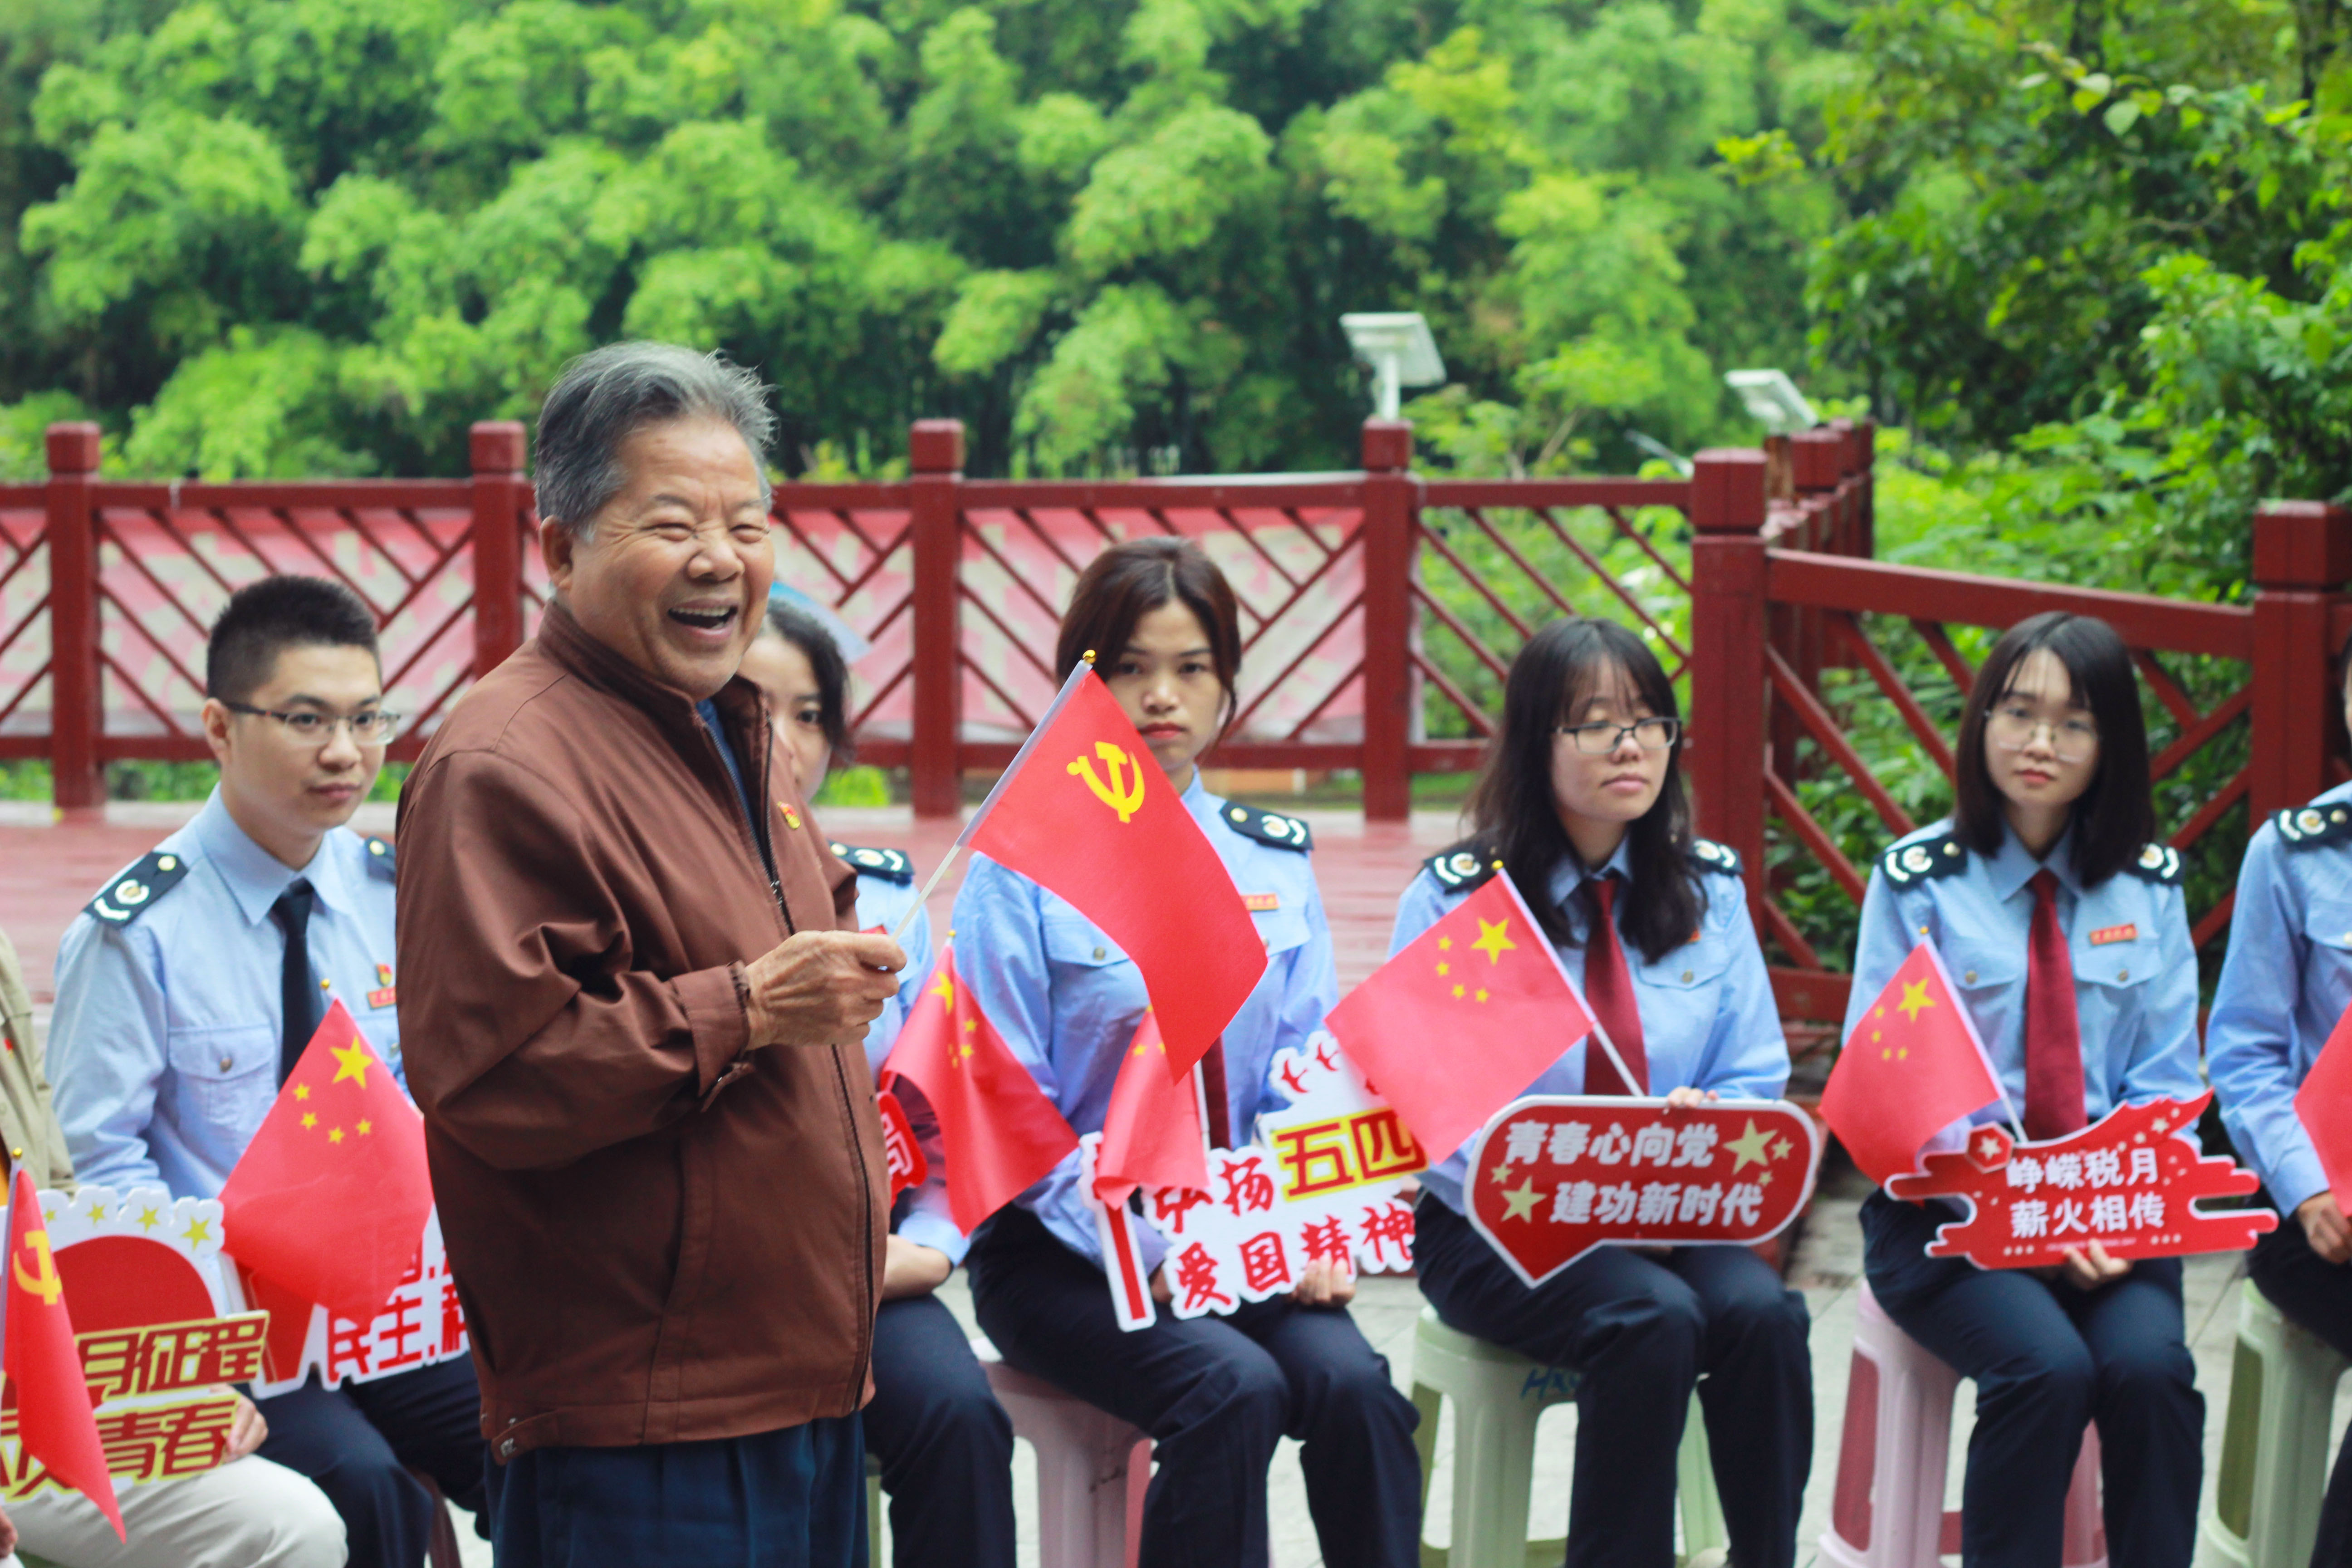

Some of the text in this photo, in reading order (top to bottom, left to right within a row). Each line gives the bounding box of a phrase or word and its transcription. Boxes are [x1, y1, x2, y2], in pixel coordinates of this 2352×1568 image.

[1504, 1119, 1719, 1168] 青春心向党
[2006, 1147, 2159, 1194] 峥嵘税月
[1549, 1180, 1764, 1226] 建功新时代
[2010, 1192, 2166, 1239] 薪火相传
[1176, 1201, 1416, 1310] 爱国精神
